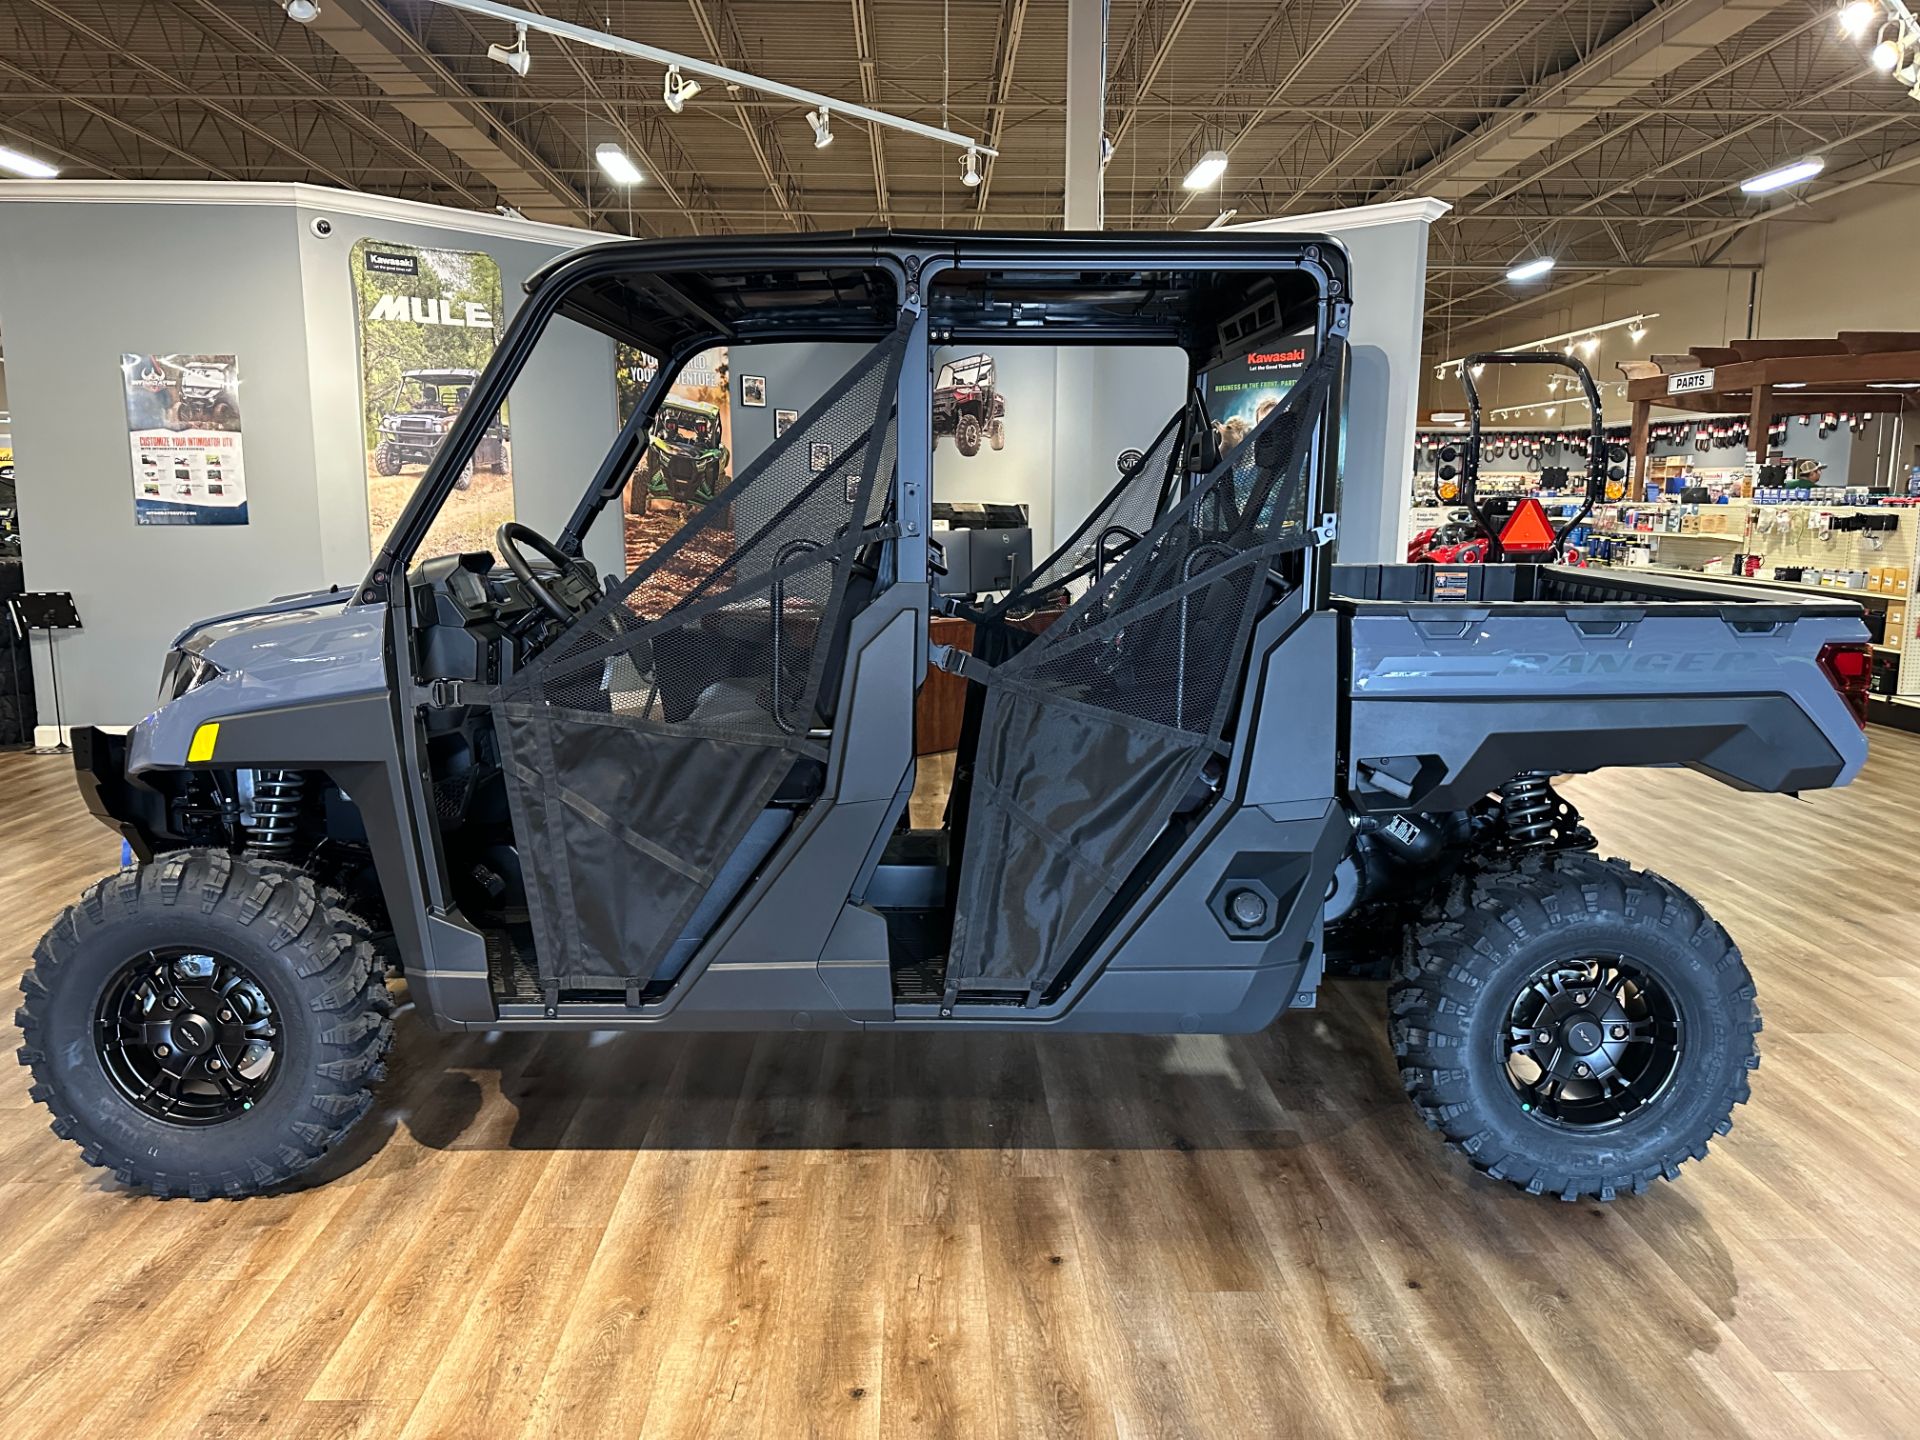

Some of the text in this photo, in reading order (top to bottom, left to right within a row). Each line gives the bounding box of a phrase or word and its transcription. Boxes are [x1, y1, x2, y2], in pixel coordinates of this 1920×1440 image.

[370, 254, 413, 267] Kawasaki
[368, 294, 495, 328] MULE
[1247, 349, 1305, 364] Kawasaki
[1215, 383, 1241, 392] BUSINESS
[1676, 375, 1705, 389] PARTS
[140, 436, 233, 447] CUSTOMIZE YOUR INTIMIDATOR UTV
[1503, 652, 1757, 674] RANGER
